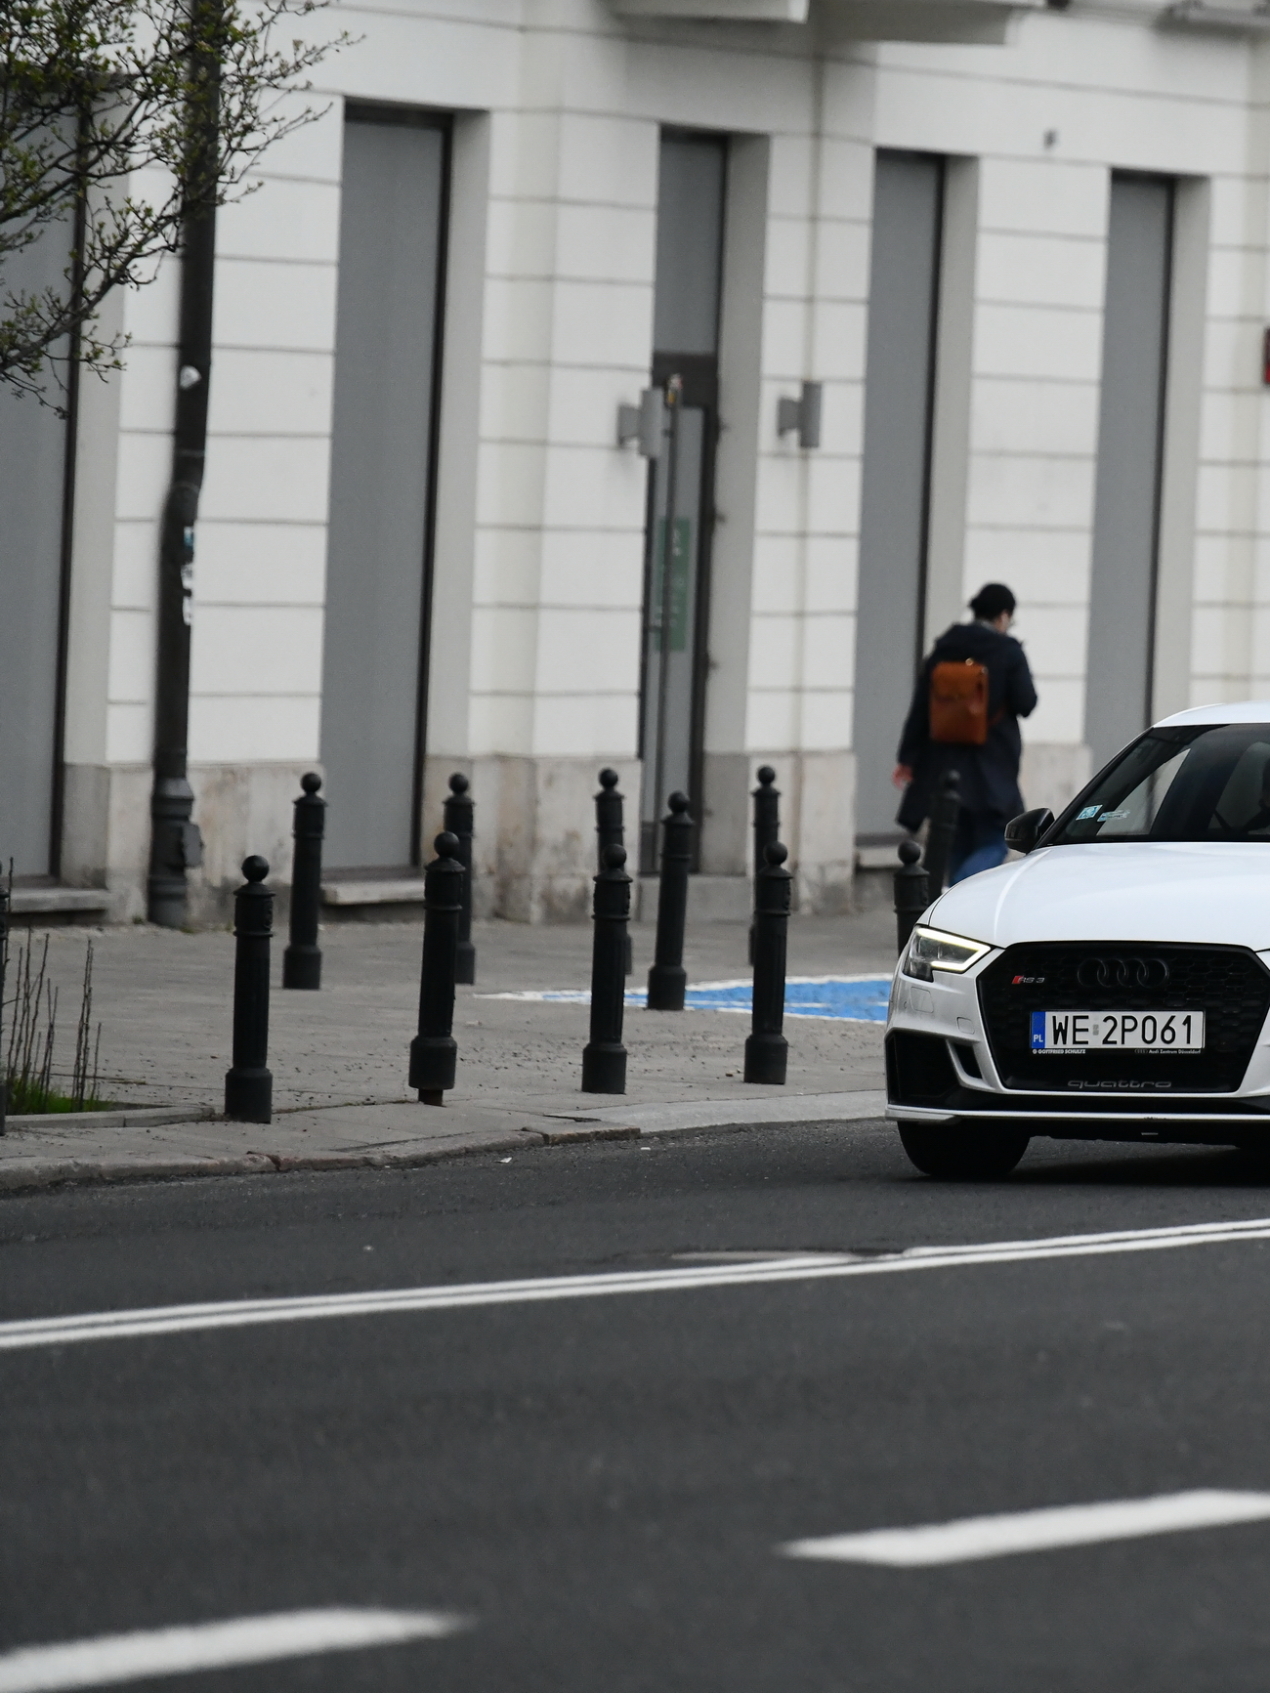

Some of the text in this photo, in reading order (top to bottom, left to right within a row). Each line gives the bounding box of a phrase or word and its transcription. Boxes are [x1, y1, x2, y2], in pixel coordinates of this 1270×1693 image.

[1052, 1015, 1192, 1045] WE 2P061
[1033, 1034, 1043, 1043] PL
[1067, 1080, 1172, 1089] quattro
